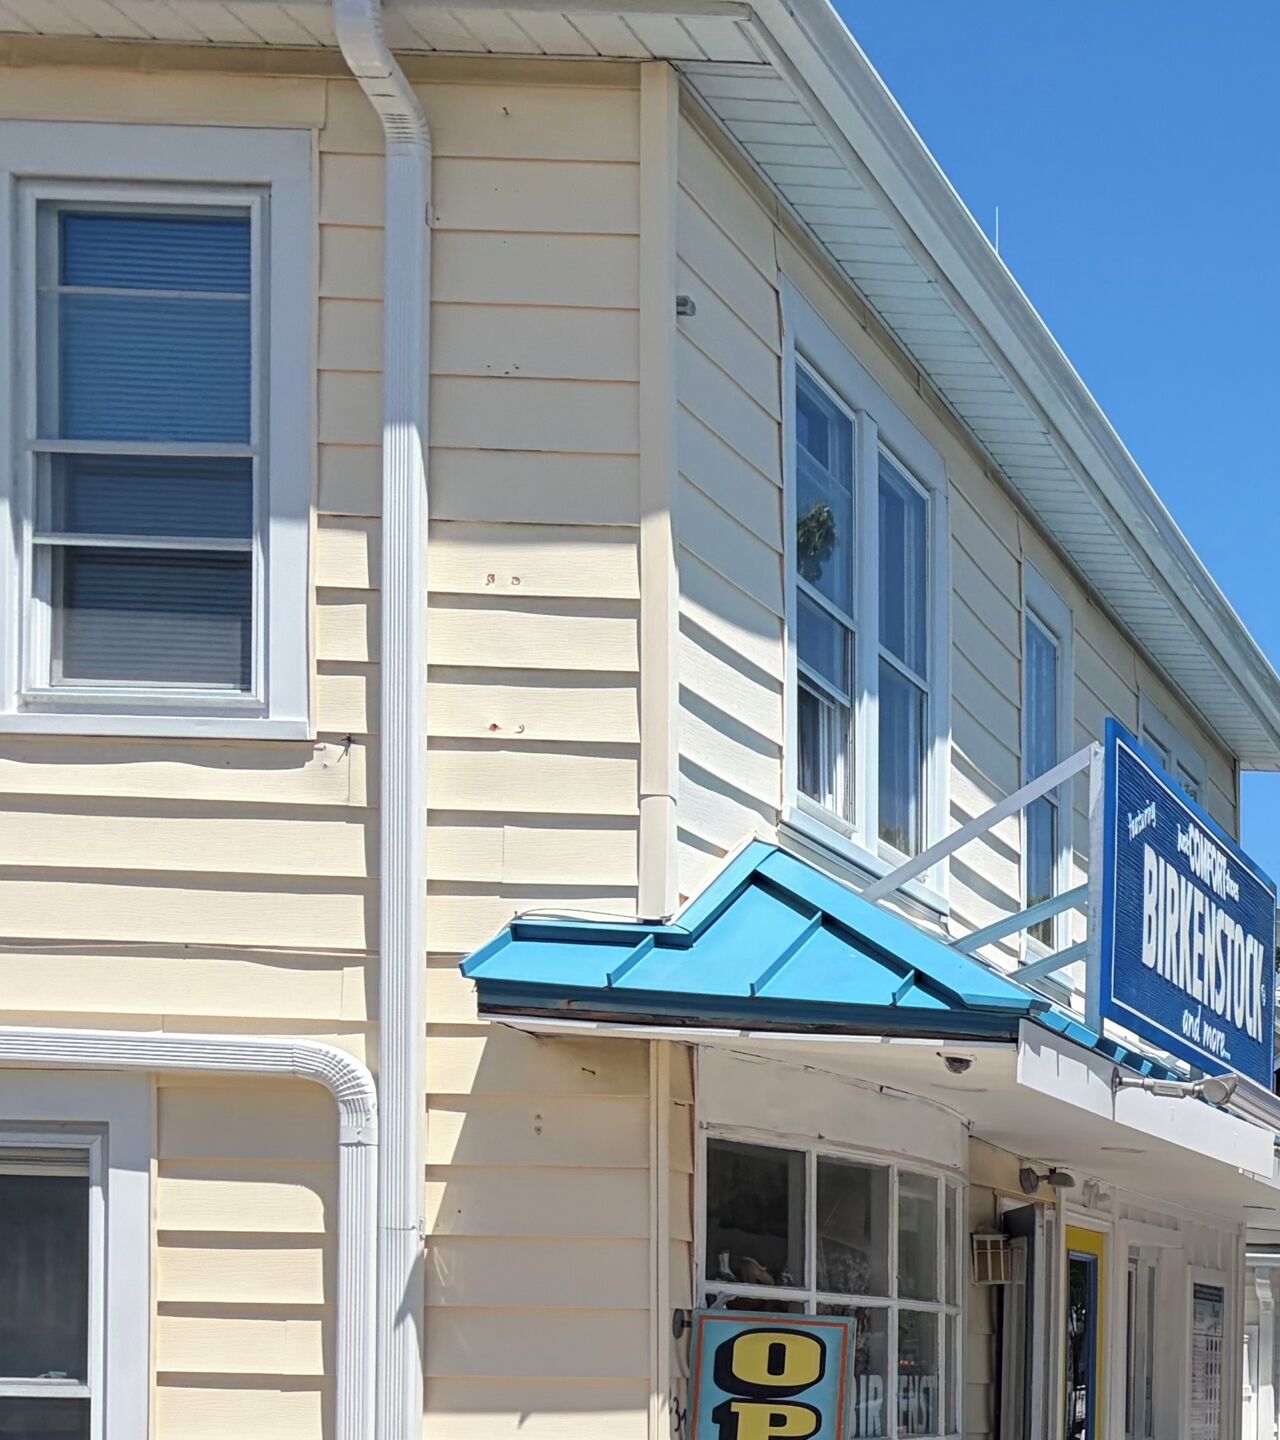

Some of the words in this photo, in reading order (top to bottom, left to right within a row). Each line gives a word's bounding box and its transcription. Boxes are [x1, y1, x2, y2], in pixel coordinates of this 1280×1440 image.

[1188, 822, 1227, 900] COMFORT
[1142, 842, 1264, 1043] BIRKENSTOCK
[1182, 1005, 1202, 1043] and
